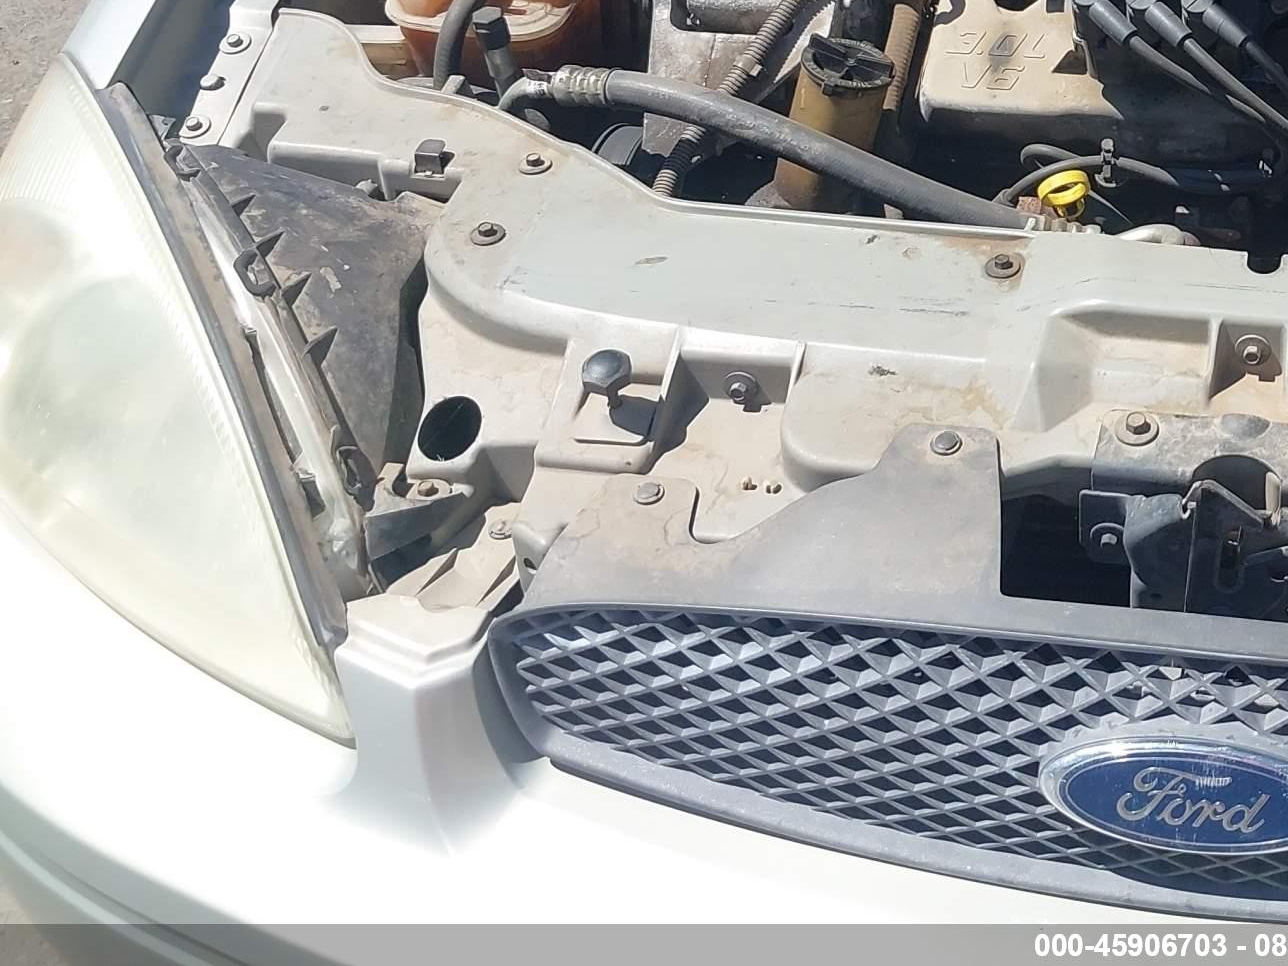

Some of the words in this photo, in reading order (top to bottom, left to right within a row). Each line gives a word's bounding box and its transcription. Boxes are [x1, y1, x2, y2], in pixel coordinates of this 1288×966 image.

[944, 30, 1046, 59] 3.0L
[960, 60, 1026, 91] V6
[1116, 766, 1271, 834] Ford
